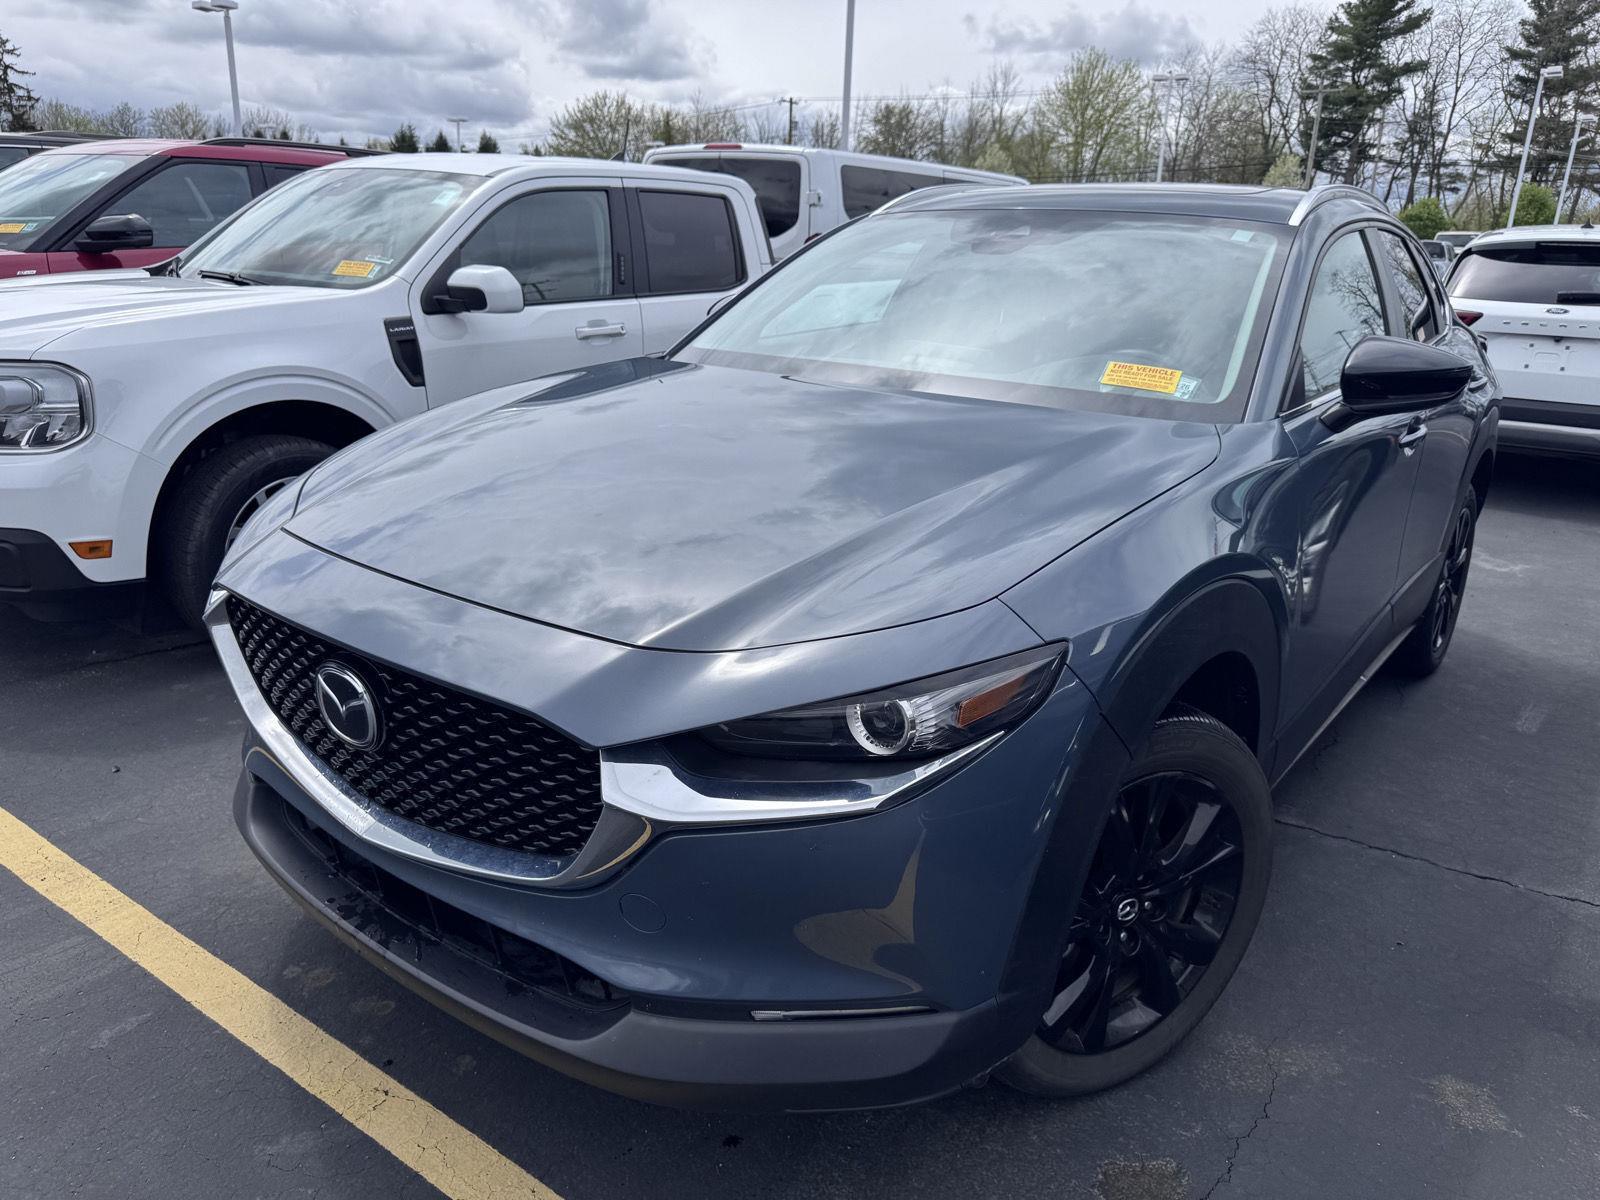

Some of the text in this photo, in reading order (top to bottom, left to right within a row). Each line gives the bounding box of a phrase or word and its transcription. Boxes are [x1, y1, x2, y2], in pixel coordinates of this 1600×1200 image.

[1113, 363, 1177, 377] THIS VEHICLE
[1123, 370, 1143, 378] READY
